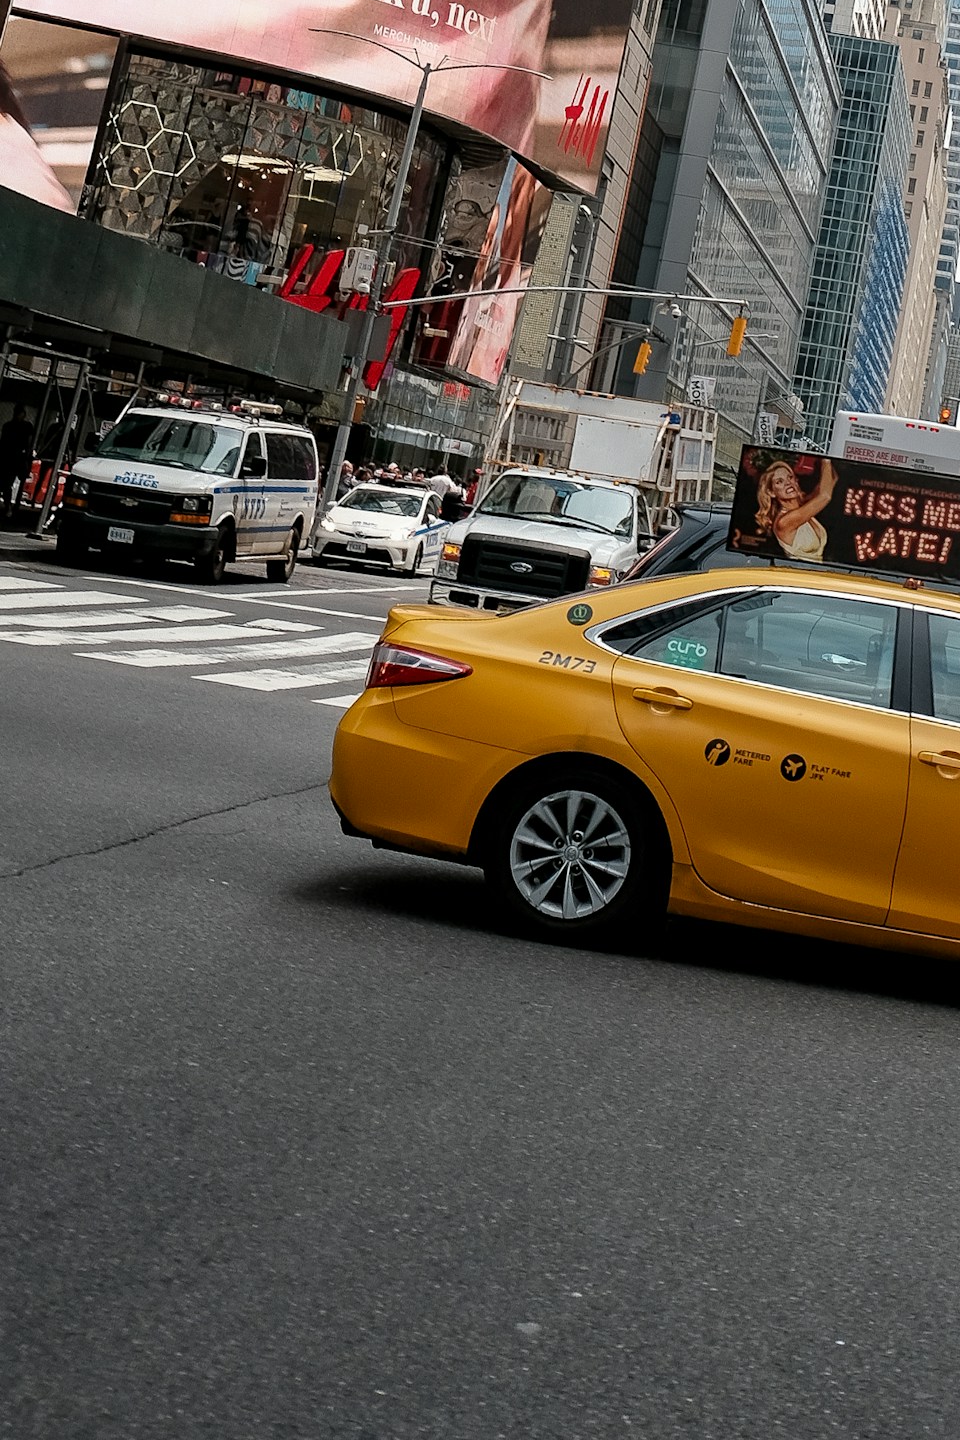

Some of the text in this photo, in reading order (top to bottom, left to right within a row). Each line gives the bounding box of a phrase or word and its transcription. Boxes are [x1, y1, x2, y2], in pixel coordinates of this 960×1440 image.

[445, 0, 498, 45] next
[373, 23, 412, 44] MERCH
[846, 445, 876, 460] CAREERS
[876, 451, 890, 461] ARE
[891, 454, 910, 464] BUILT
[113, 474, 159, 488] POLICE
[125, 471, 155, 479] NYPD
[860, 479, 885, 491] LIMITED
[885, 481, 919, 495] BROADWAY
[844, 487, 915, 524] KISS
[854, 527, 951, 564] KATE!
[668, 640, 708, 657] curb
[539, 650, 598, 674] 2M73
[733, 756, 753, 766] FARE
[735, 748, 771, 762] METERED
[811, 764, 851, 778] FLAT FARE
